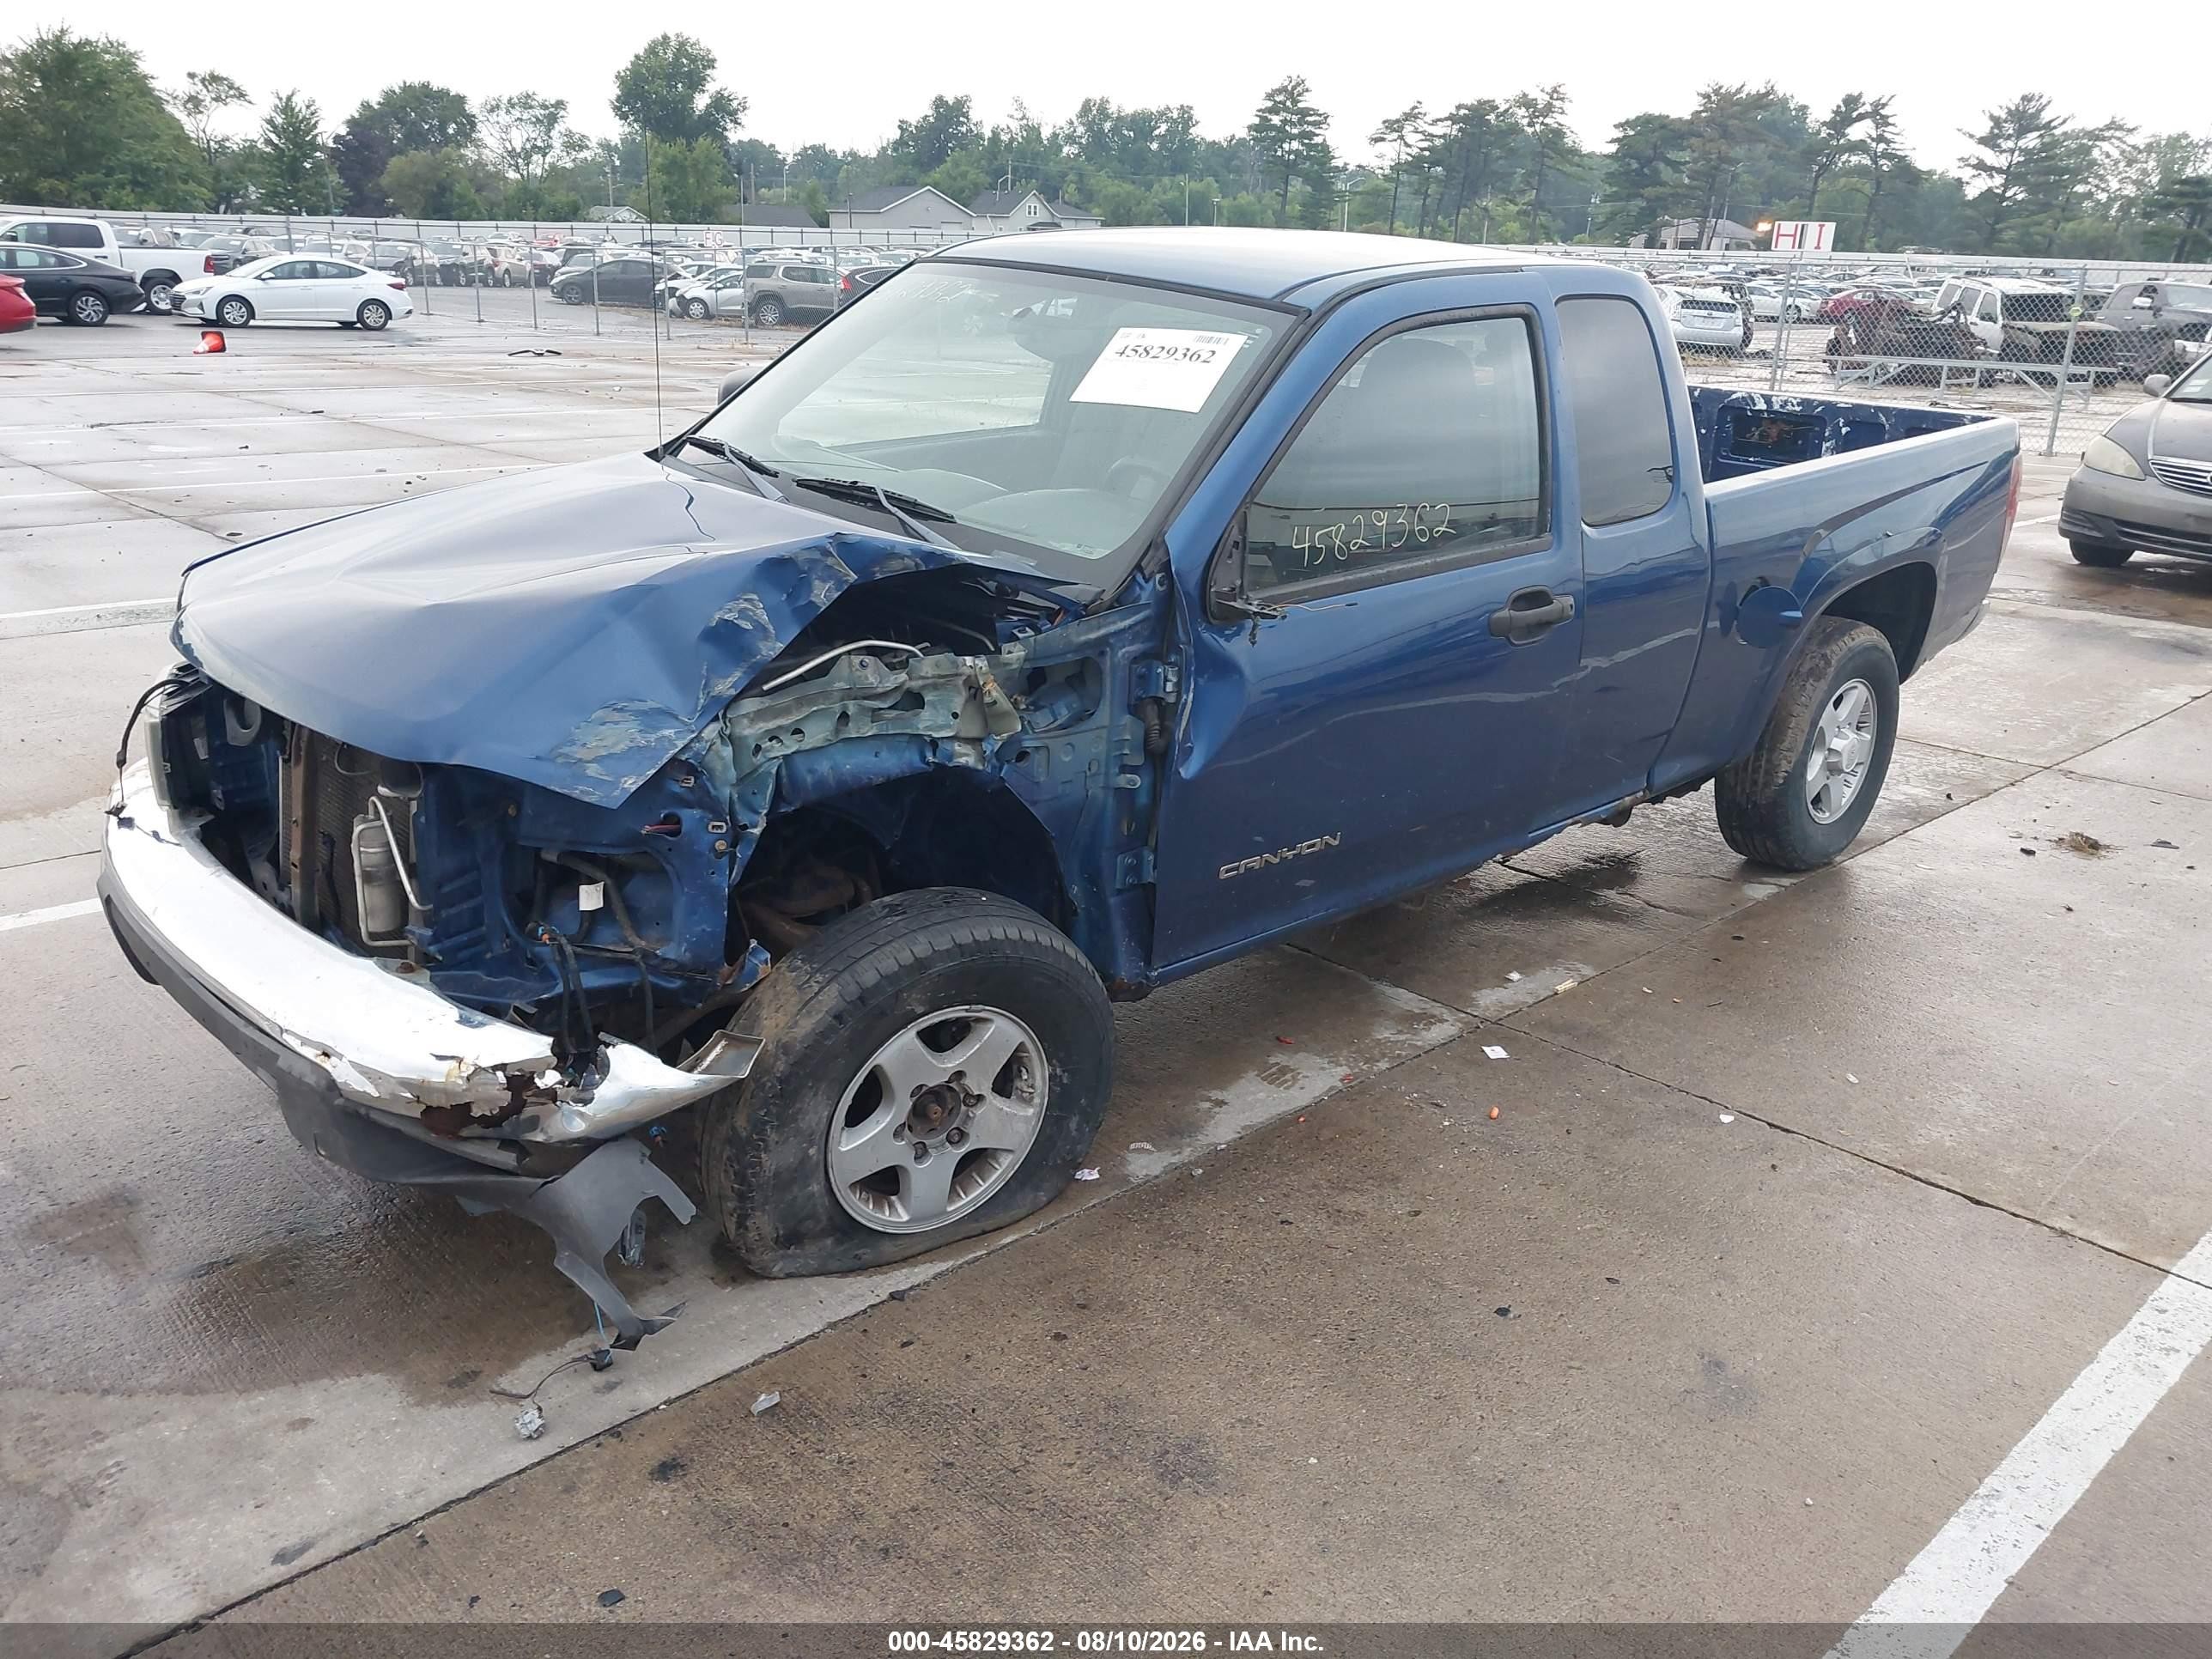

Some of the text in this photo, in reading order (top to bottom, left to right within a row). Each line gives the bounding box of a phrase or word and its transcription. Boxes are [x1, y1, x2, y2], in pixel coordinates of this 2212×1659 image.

[1115, 344, 1217, 364] 45829362
[1291, 502, 1456, 568] 45829362
[1218, 831, 1341, 880] CANYON
